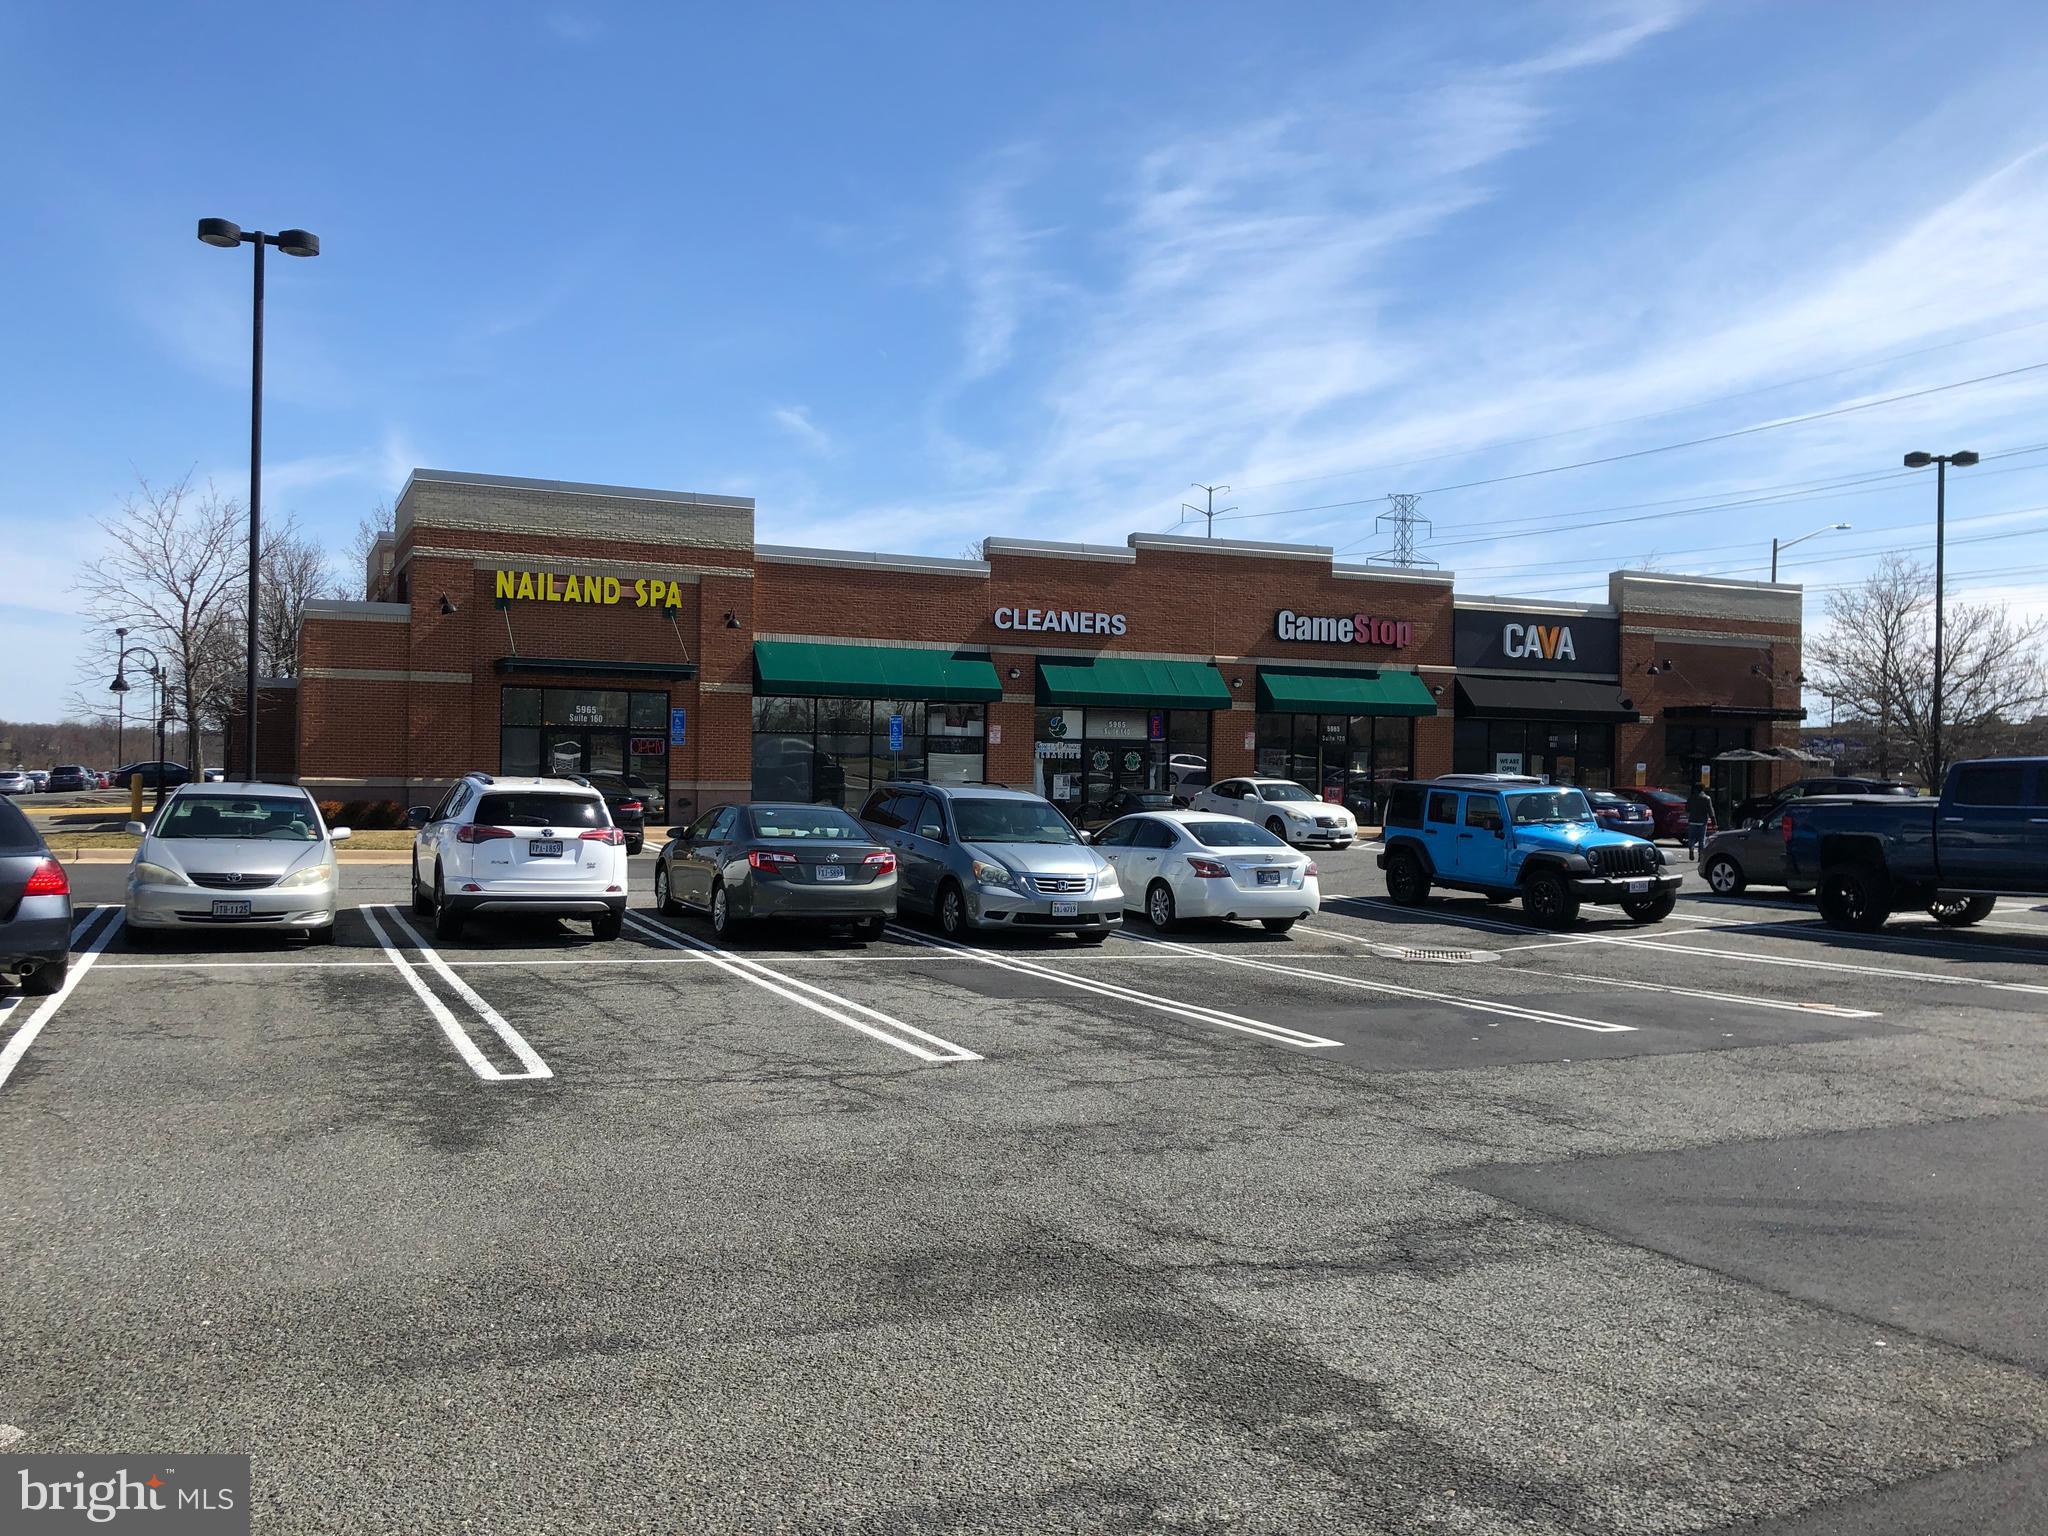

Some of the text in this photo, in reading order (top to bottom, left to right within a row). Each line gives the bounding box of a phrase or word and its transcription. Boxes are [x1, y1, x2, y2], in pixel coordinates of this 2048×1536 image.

[635, 578, 682, 608] SPA
[994, 607, 1127, 635] CLEANERS
[1277, 609, 1412, 648] GameStop
[1503, 623, 1577, 660] CAVA
[569, 713, 603, 723] Suite 160
[576, 705, 597, 714] 5965
